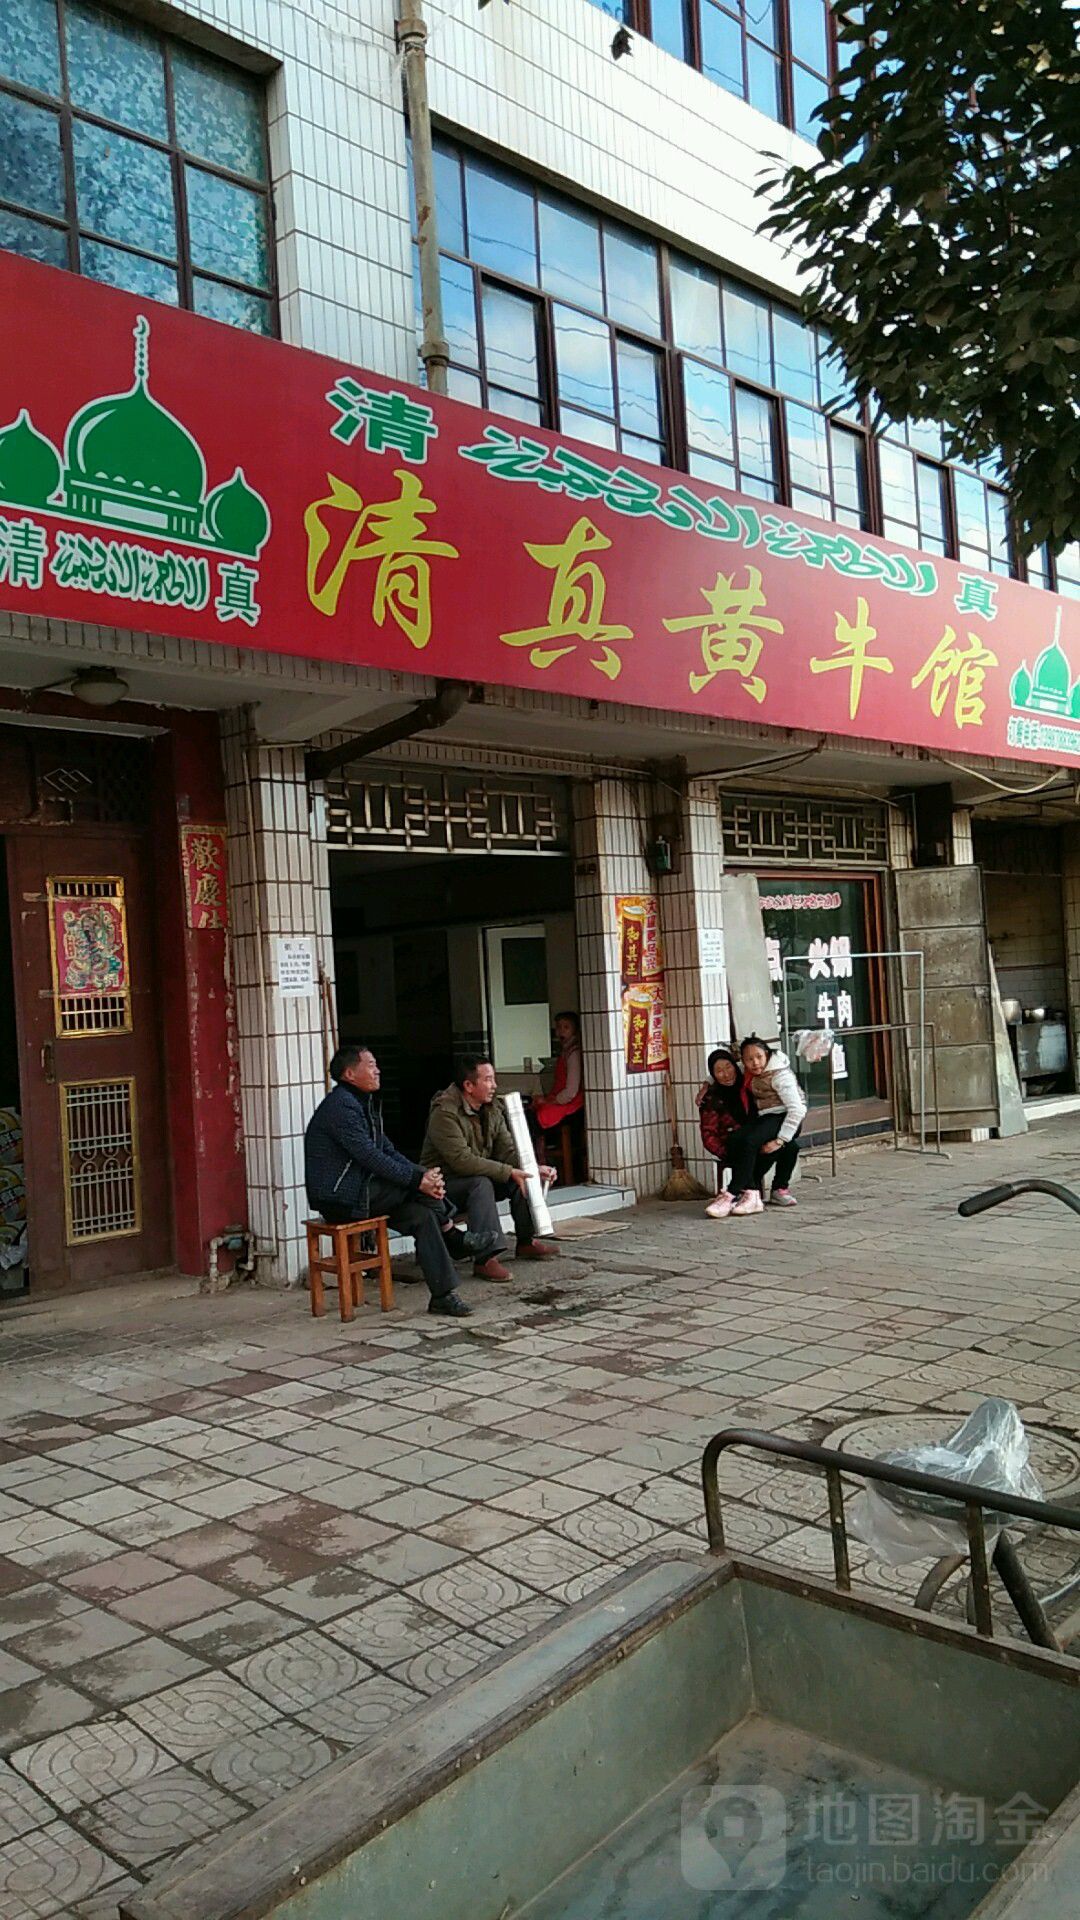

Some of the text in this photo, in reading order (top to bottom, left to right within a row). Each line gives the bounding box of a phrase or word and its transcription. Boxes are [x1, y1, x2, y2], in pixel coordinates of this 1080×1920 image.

[326, 377, 438, 463] 清
[0, 519, 47, 589] 清
[215, 562, 261, 627] 真
[303, 469, 999, 728] 清真黄牛馆
[954, 572, 999, 621] 真
[817, 990, 853, 1030] 牛肉
